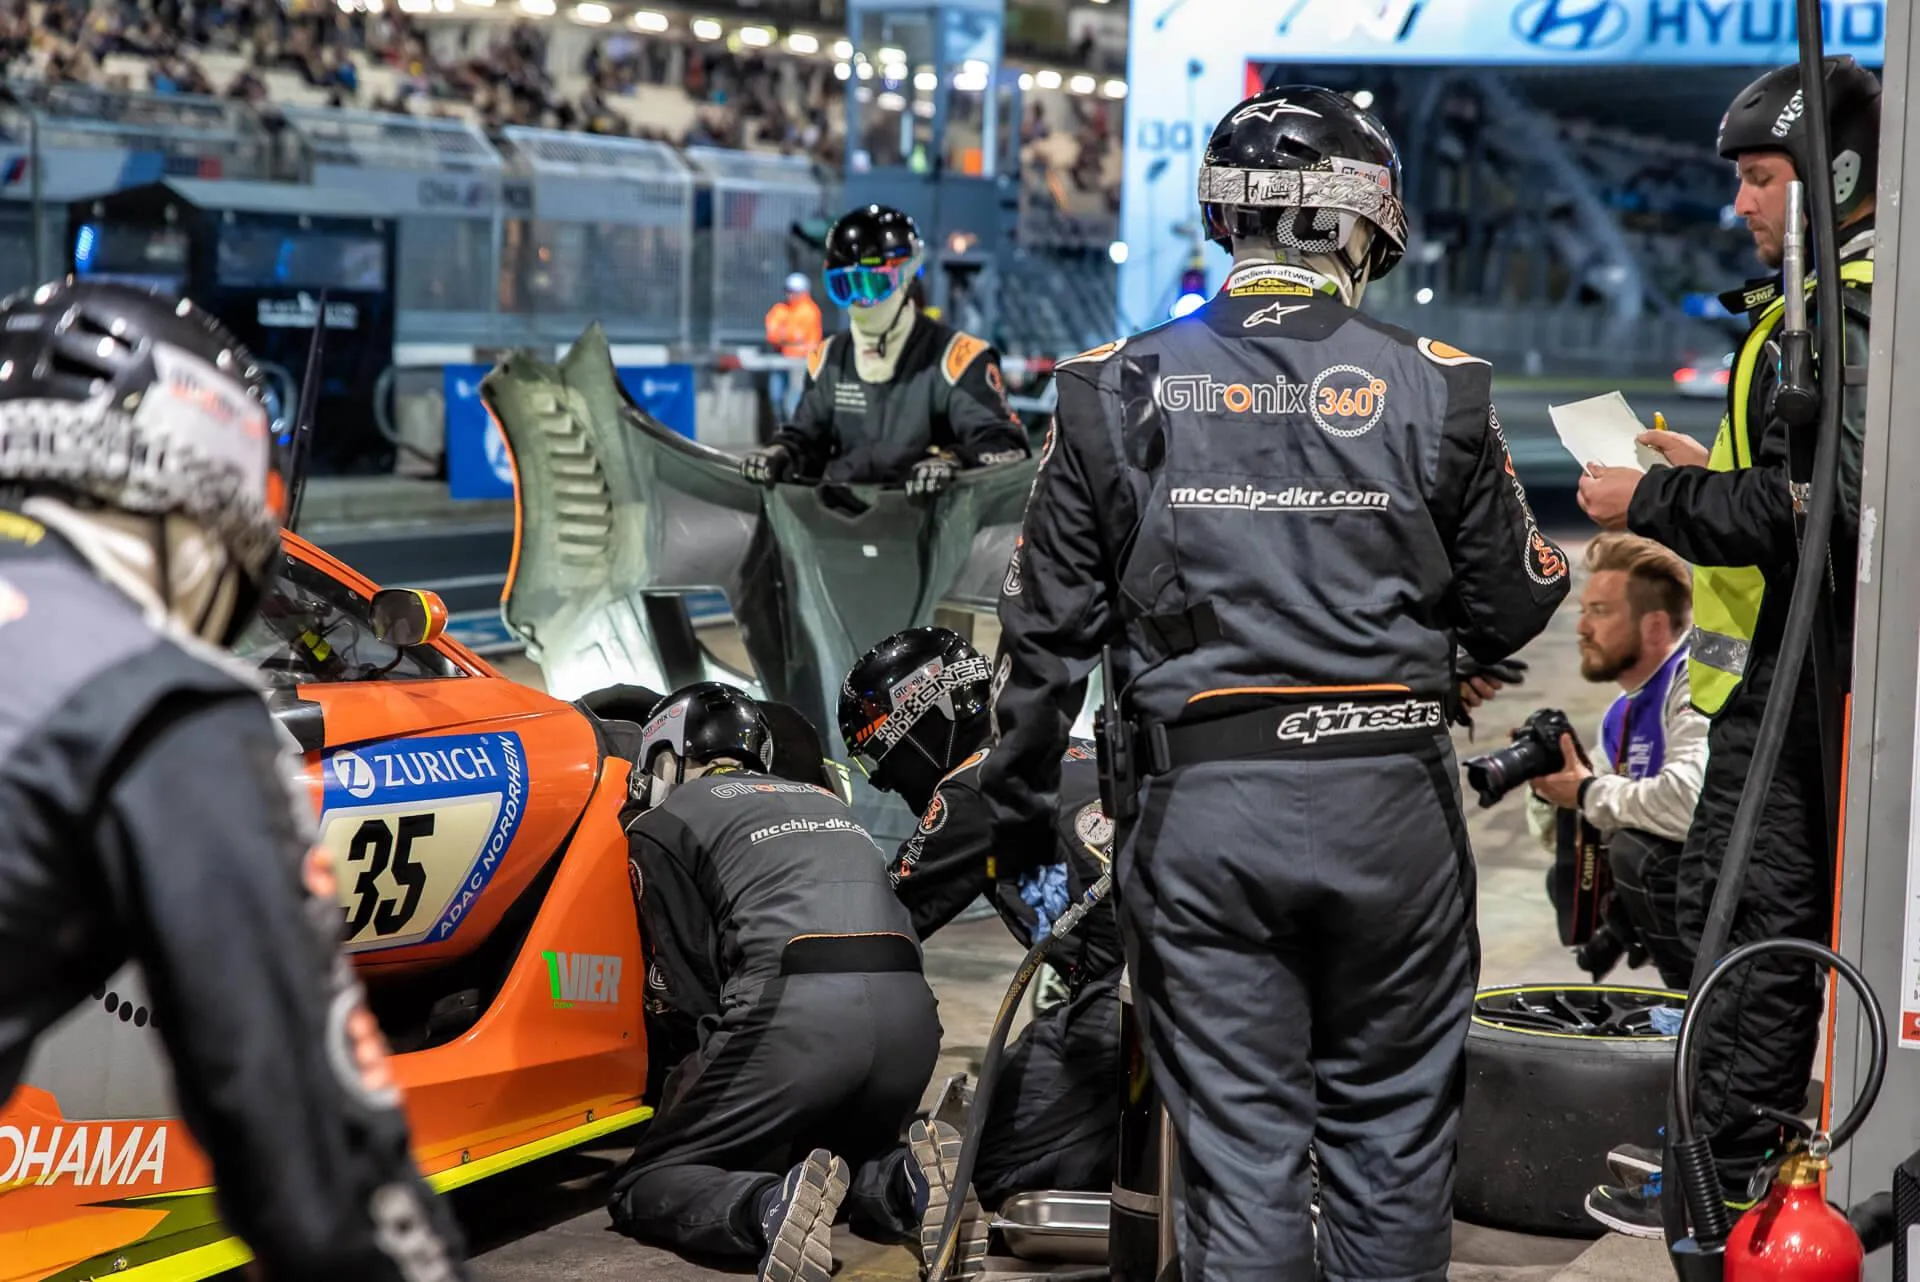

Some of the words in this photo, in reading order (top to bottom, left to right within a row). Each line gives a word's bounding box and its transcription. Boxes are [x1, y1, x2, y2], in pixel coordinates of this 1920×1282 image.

[1744, 287, 1775, 304] OMP
[1160, 374, 1309, 413] GTronix
[1169, 484, 1391, 510] mcchip-dkr.com
[874, 703, 909, 741] ENJOY
[886, 711, 917, 746] RIDE
[375, 746, 498, 788] ZURICH
[440, 871, 483, 938] ADAC
[482, 734, 522, 872] NORDRHEIN
[336, 812, 435, 940] 35
[1581, 843, 1596, 891] Canon
